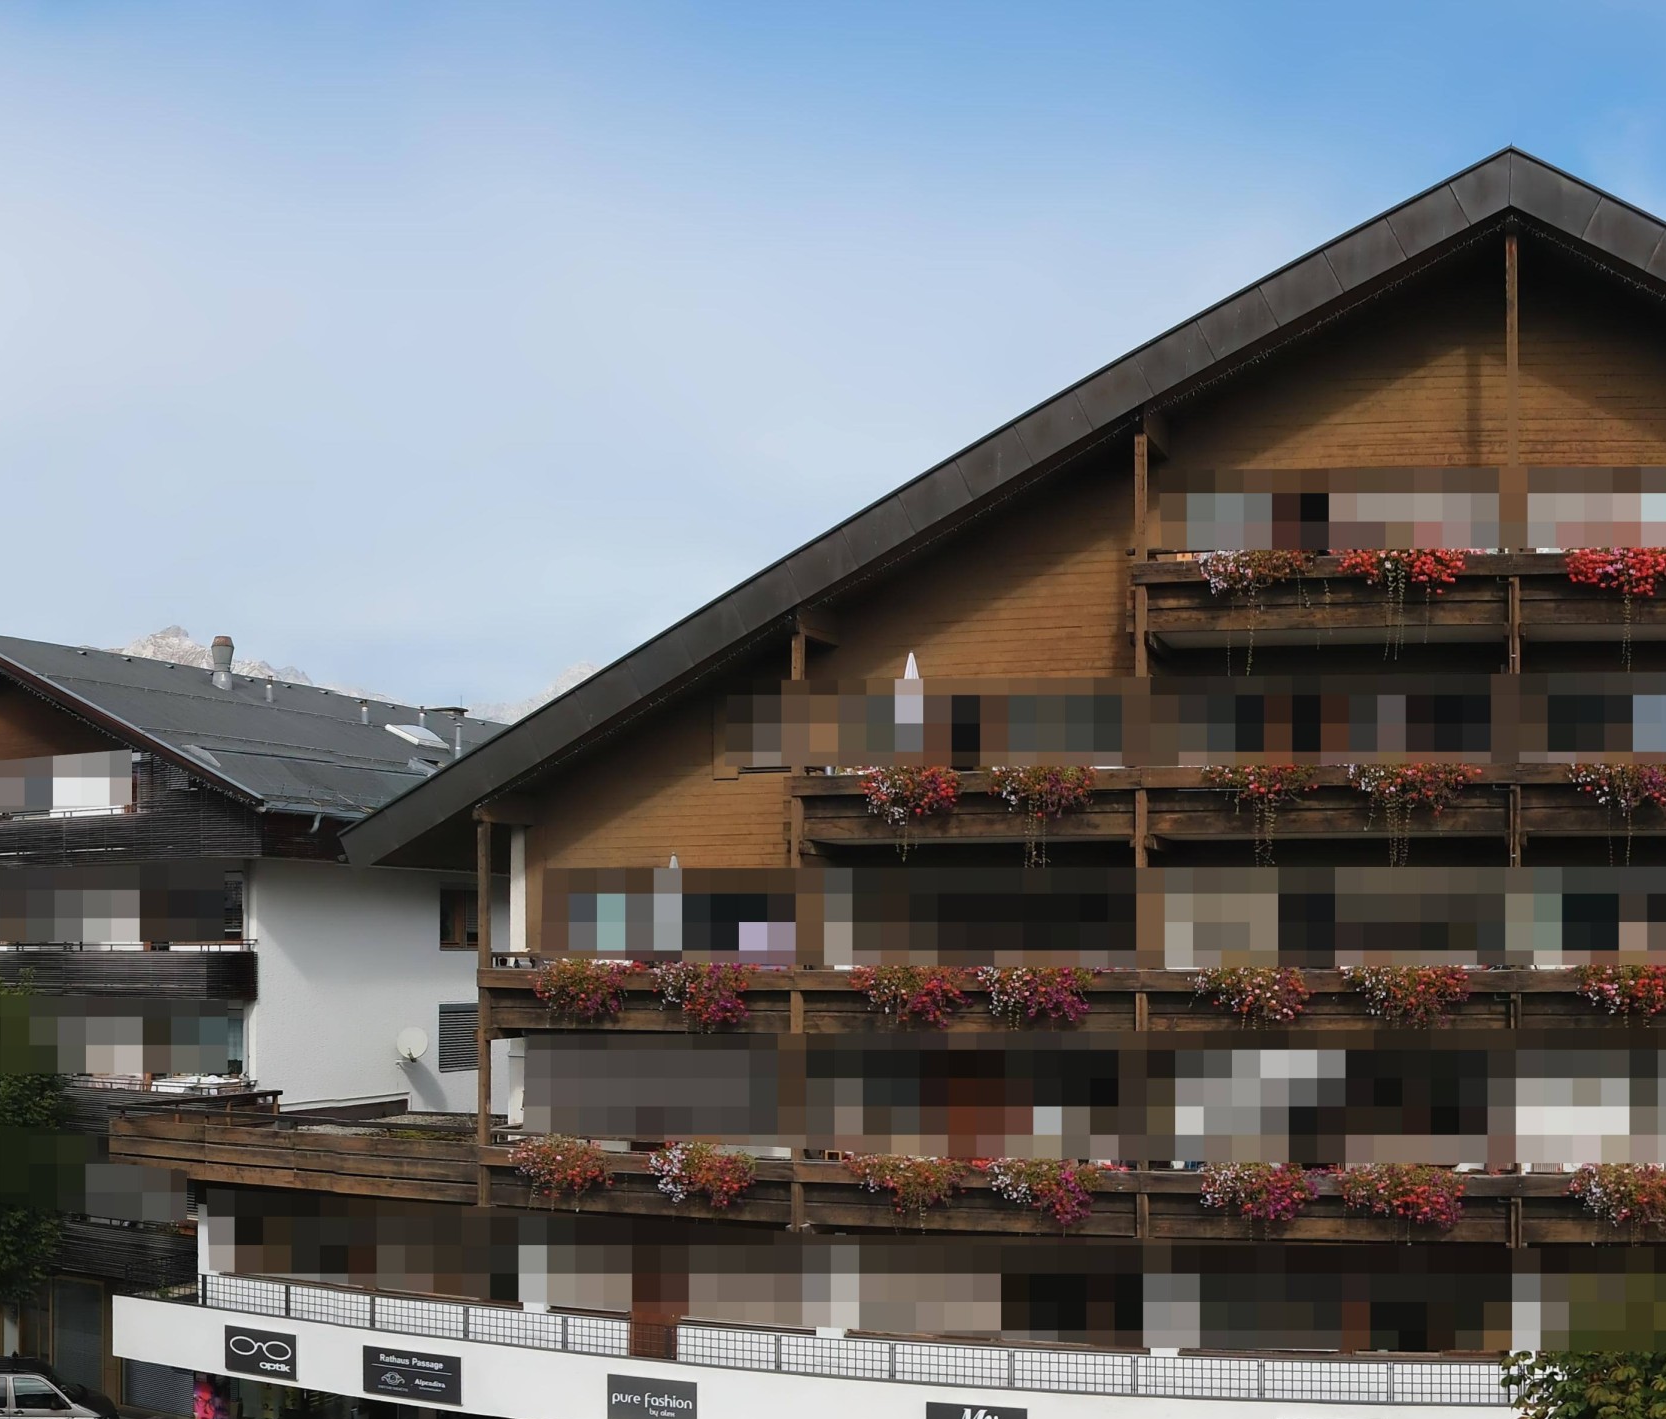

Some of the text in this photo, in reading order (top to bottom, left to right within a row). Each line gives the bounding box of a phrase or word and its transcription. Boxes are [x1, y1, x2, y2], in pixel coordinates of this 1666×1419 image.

[259, 1361, 291, 1373] optik
[379, 1353, 444, 1370] Rathaus Passage
[612, 1392, 641, 1404] pure
[649, 1408, 675, 1418] by alex
